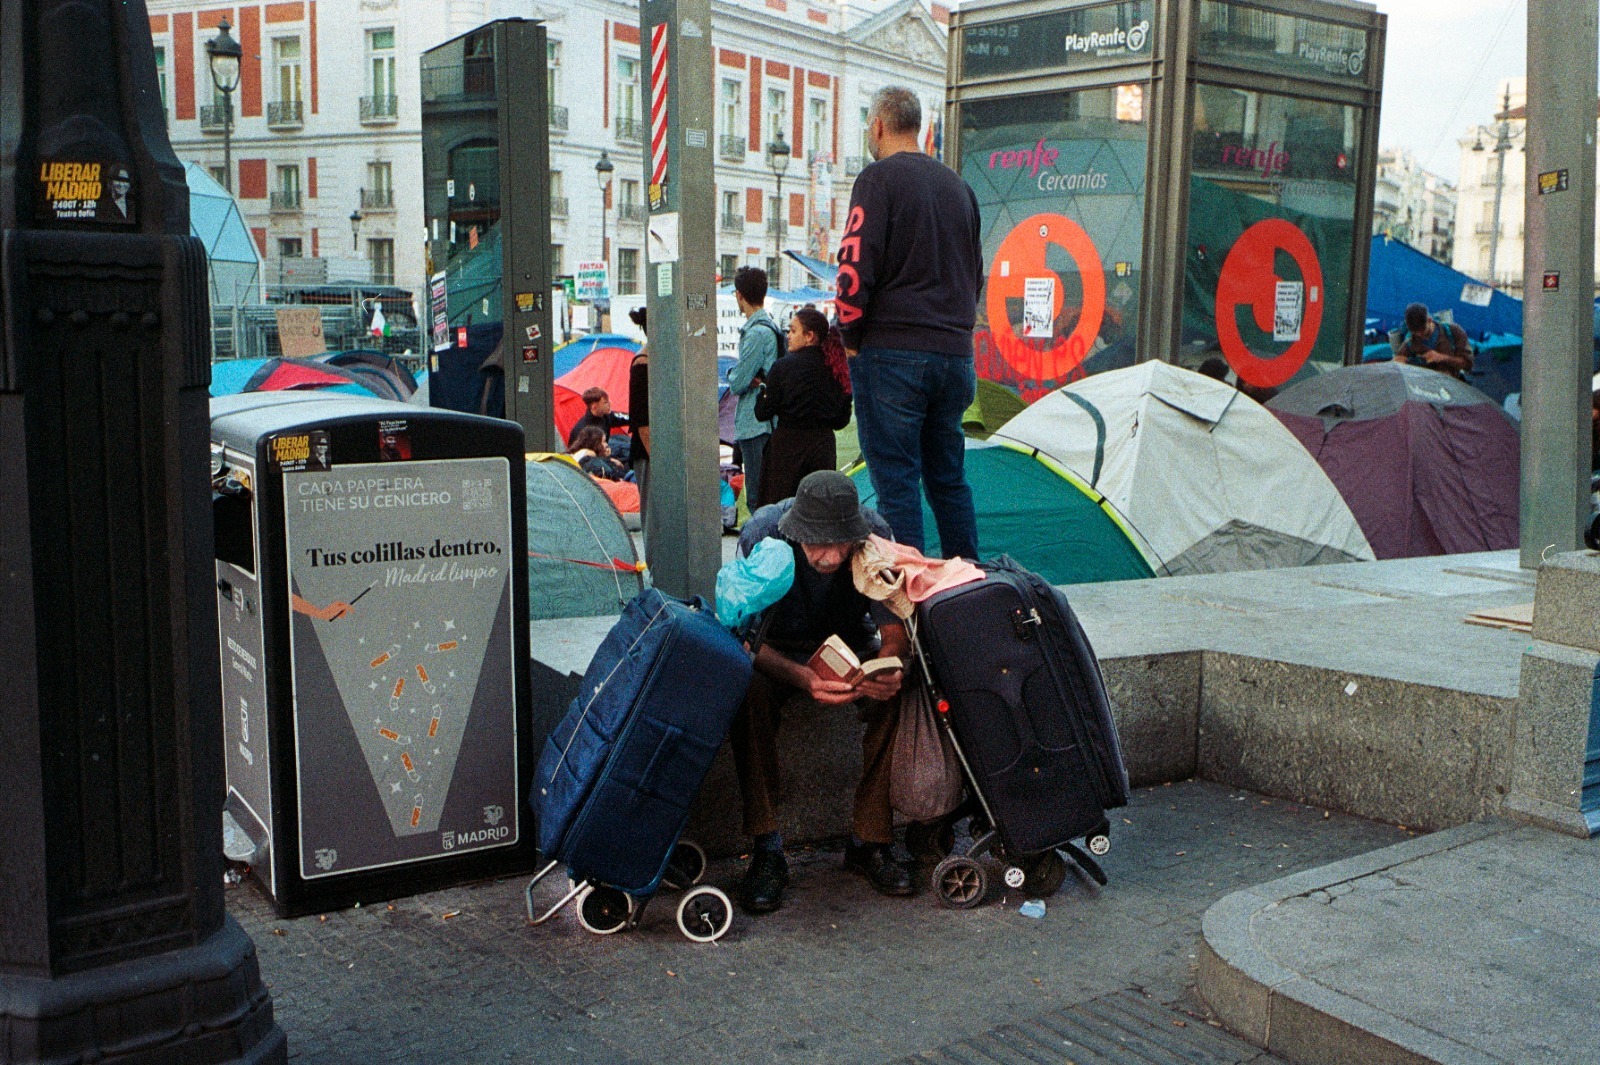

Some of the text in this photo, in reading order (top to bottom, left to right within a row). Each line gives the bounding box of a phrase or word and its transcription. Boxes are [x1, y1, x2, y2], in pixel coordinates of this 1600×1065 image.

[1065, 28, 1125, 52] PlayRenfe
[1299, 42, 1348, 65] PlayRenfe
[988, 138, 1059, 179] renfe
[1221, 141, 1290, 179] renfe
[41, 162, 101, 182] LIBERAR
[1037, 168, 1108, 191] Cercanías
[46, 180, 102, 200] MADRID
[836, 204, 864, 325] SECA
[273, 436, 309, 450] LIBERAR
[276, 448, 310, 461] MADRID
[298, 477, 425, 496] CADA PAPELERA
[301, 491, 451, 513] TIENE SU CENICERO
[306, 538, 502, 567] Tus colillas dentro,
[384, 561, 499, 588] Madrid limpio
[457, 826, 509, 845] MADRID
